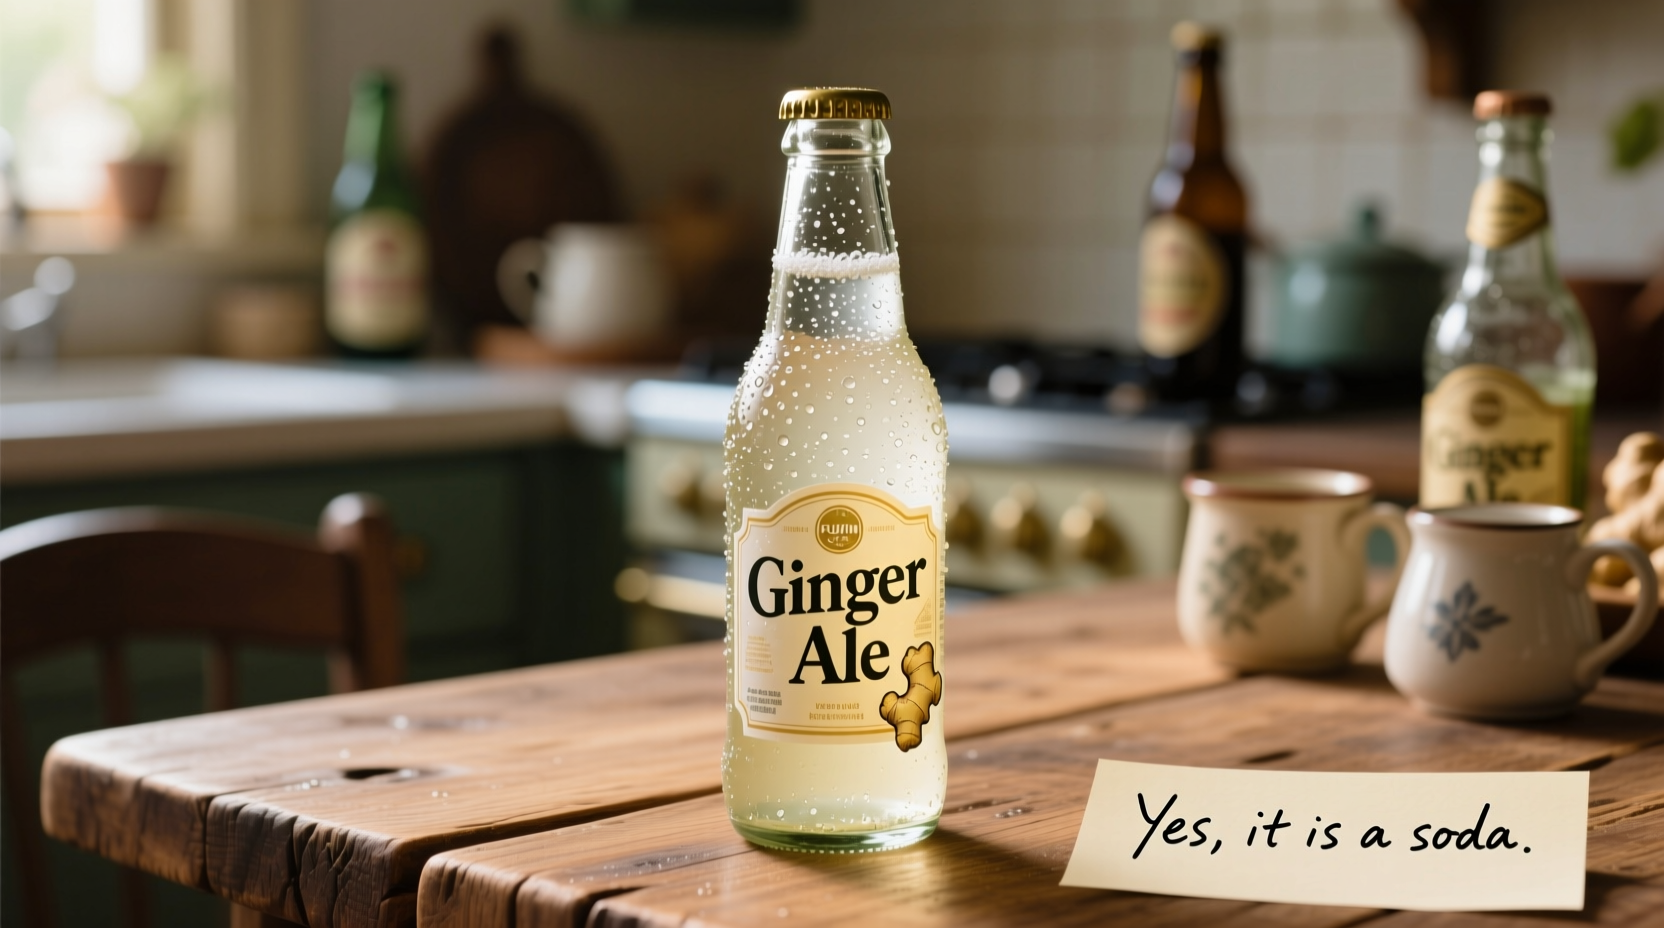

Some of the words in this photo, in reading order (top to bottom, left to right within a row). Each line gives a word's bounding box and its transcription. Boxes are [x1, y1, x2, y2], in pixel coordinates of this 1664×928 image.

[748, 556, 927, 626] Ginger
[788, 625, 890, 685] Ale
[1132, 792, 1223, 860] Yes,
[1246, 808, 1292, 848] it
[1306, 815, 1342, 850] is
[1360, 825, 1392, 849] a
[1409, 802, 1532, 854] soda.
